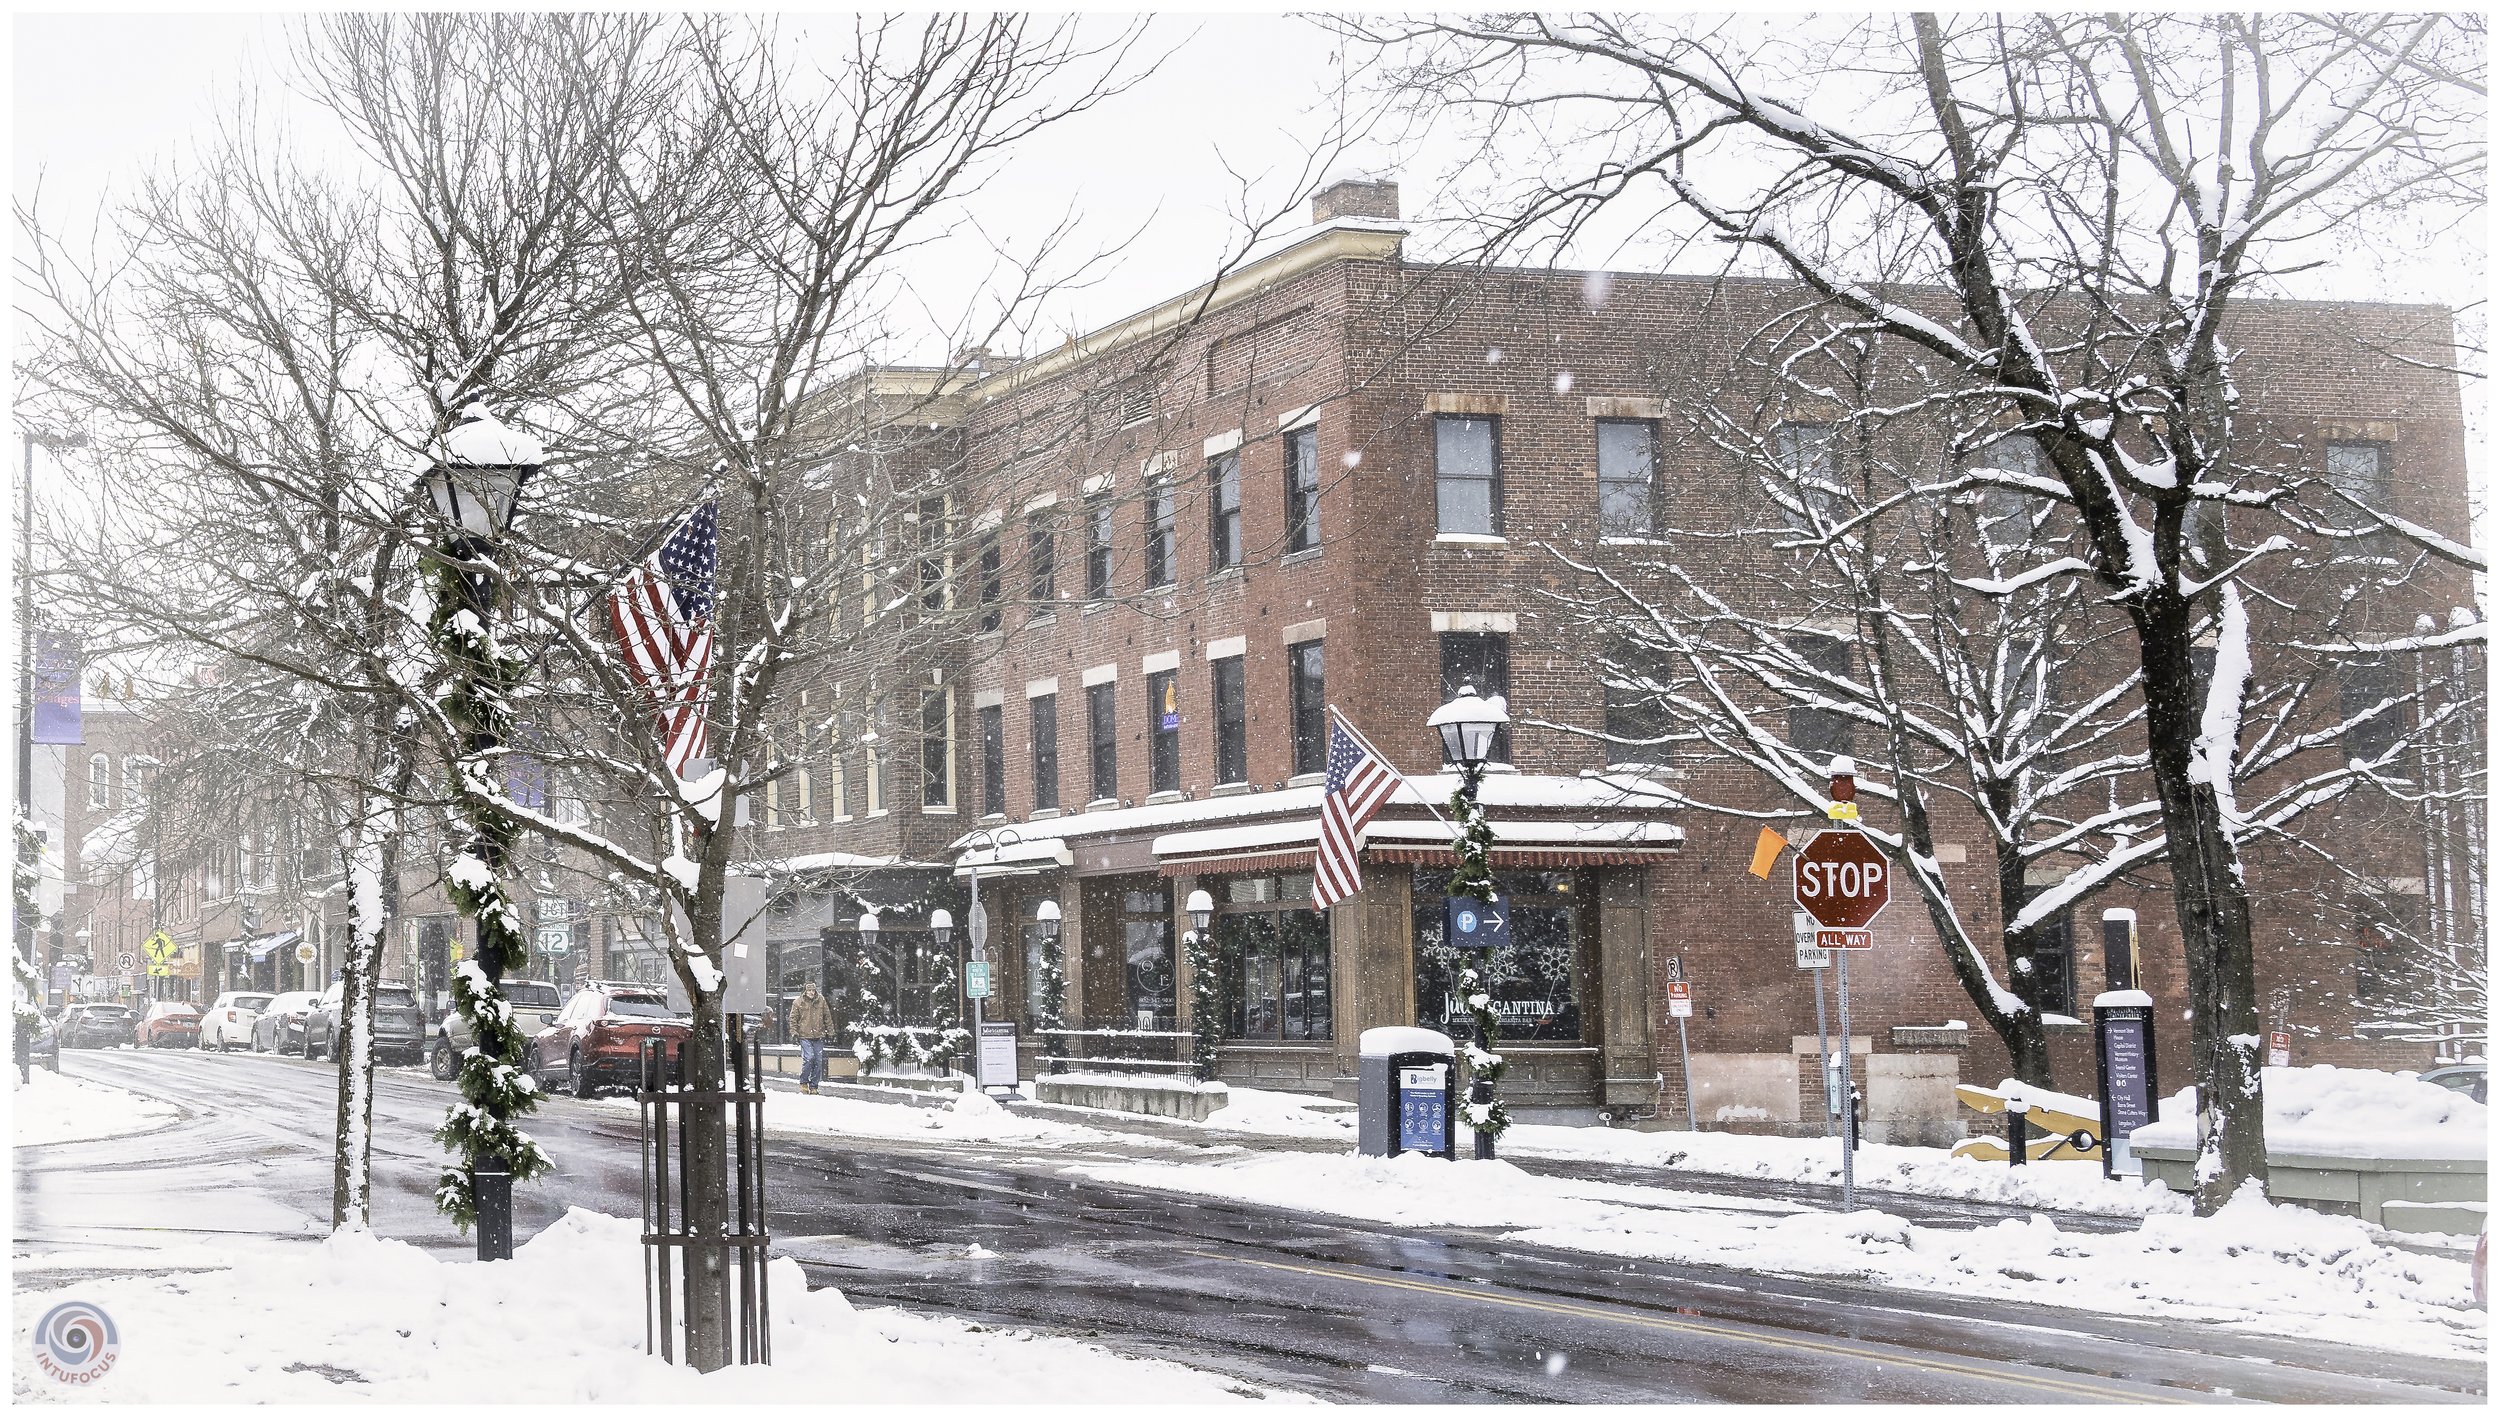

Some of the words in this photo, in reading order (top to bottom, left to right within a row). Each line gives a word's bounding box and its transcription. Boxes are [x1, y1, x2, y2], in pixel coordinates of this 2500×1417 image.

[1801, 861, 1882, 898] STOP
[1462, 913, 1474, 930] P
[544, 933, 563, 950] 12
[1796, 932, 1815, 944] OVERN
[1821, 934, 1841, 946] ALL
[1845, 934, 1867, 946] WAY
[1800, 949, 1828, 960] PARKING
[1673, 985, 1683, 993] NO
[1493, 1000, 1554, 1015] CANTINA
